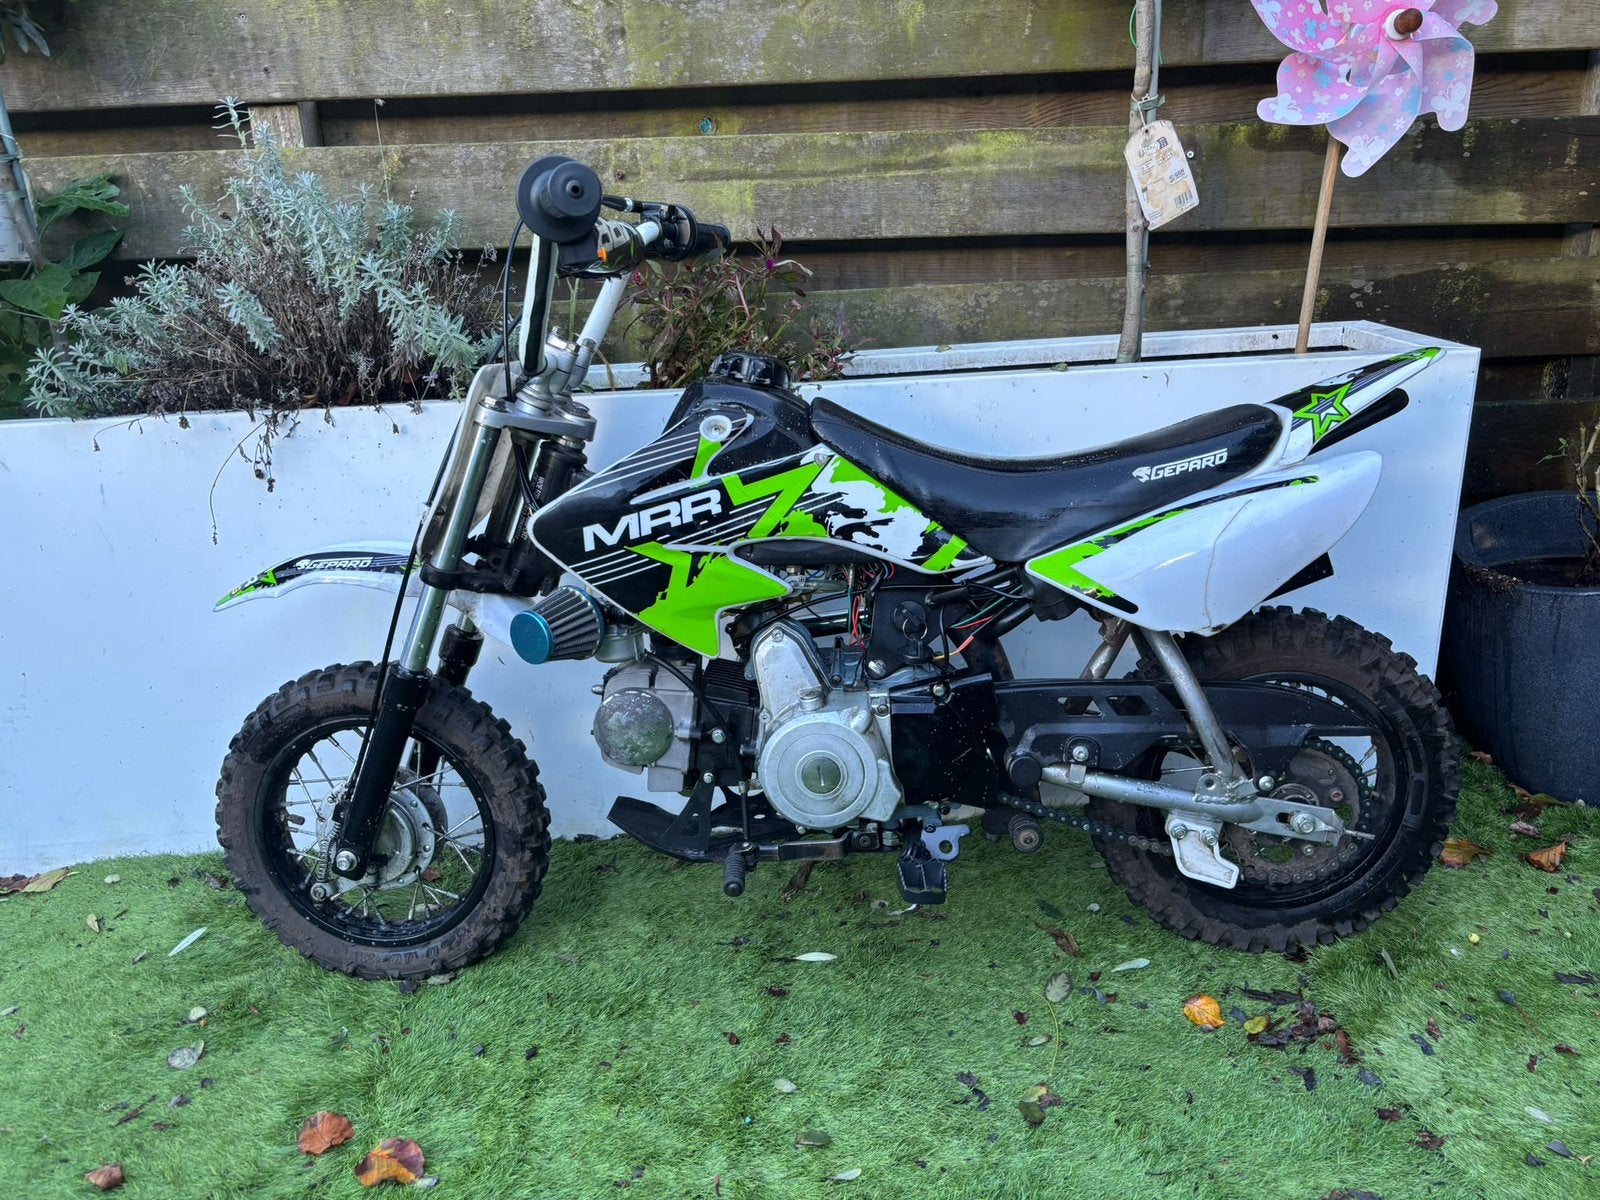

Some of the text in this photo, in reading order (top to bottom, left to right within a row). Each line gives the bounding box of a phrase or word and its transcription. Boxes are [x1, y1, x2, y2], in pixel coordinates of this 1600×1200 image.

[1150, 448, 1228, 481] GEPARD
[582, 489, 722, 552] MRR
[308, 556, 374, 569] GEPARD
